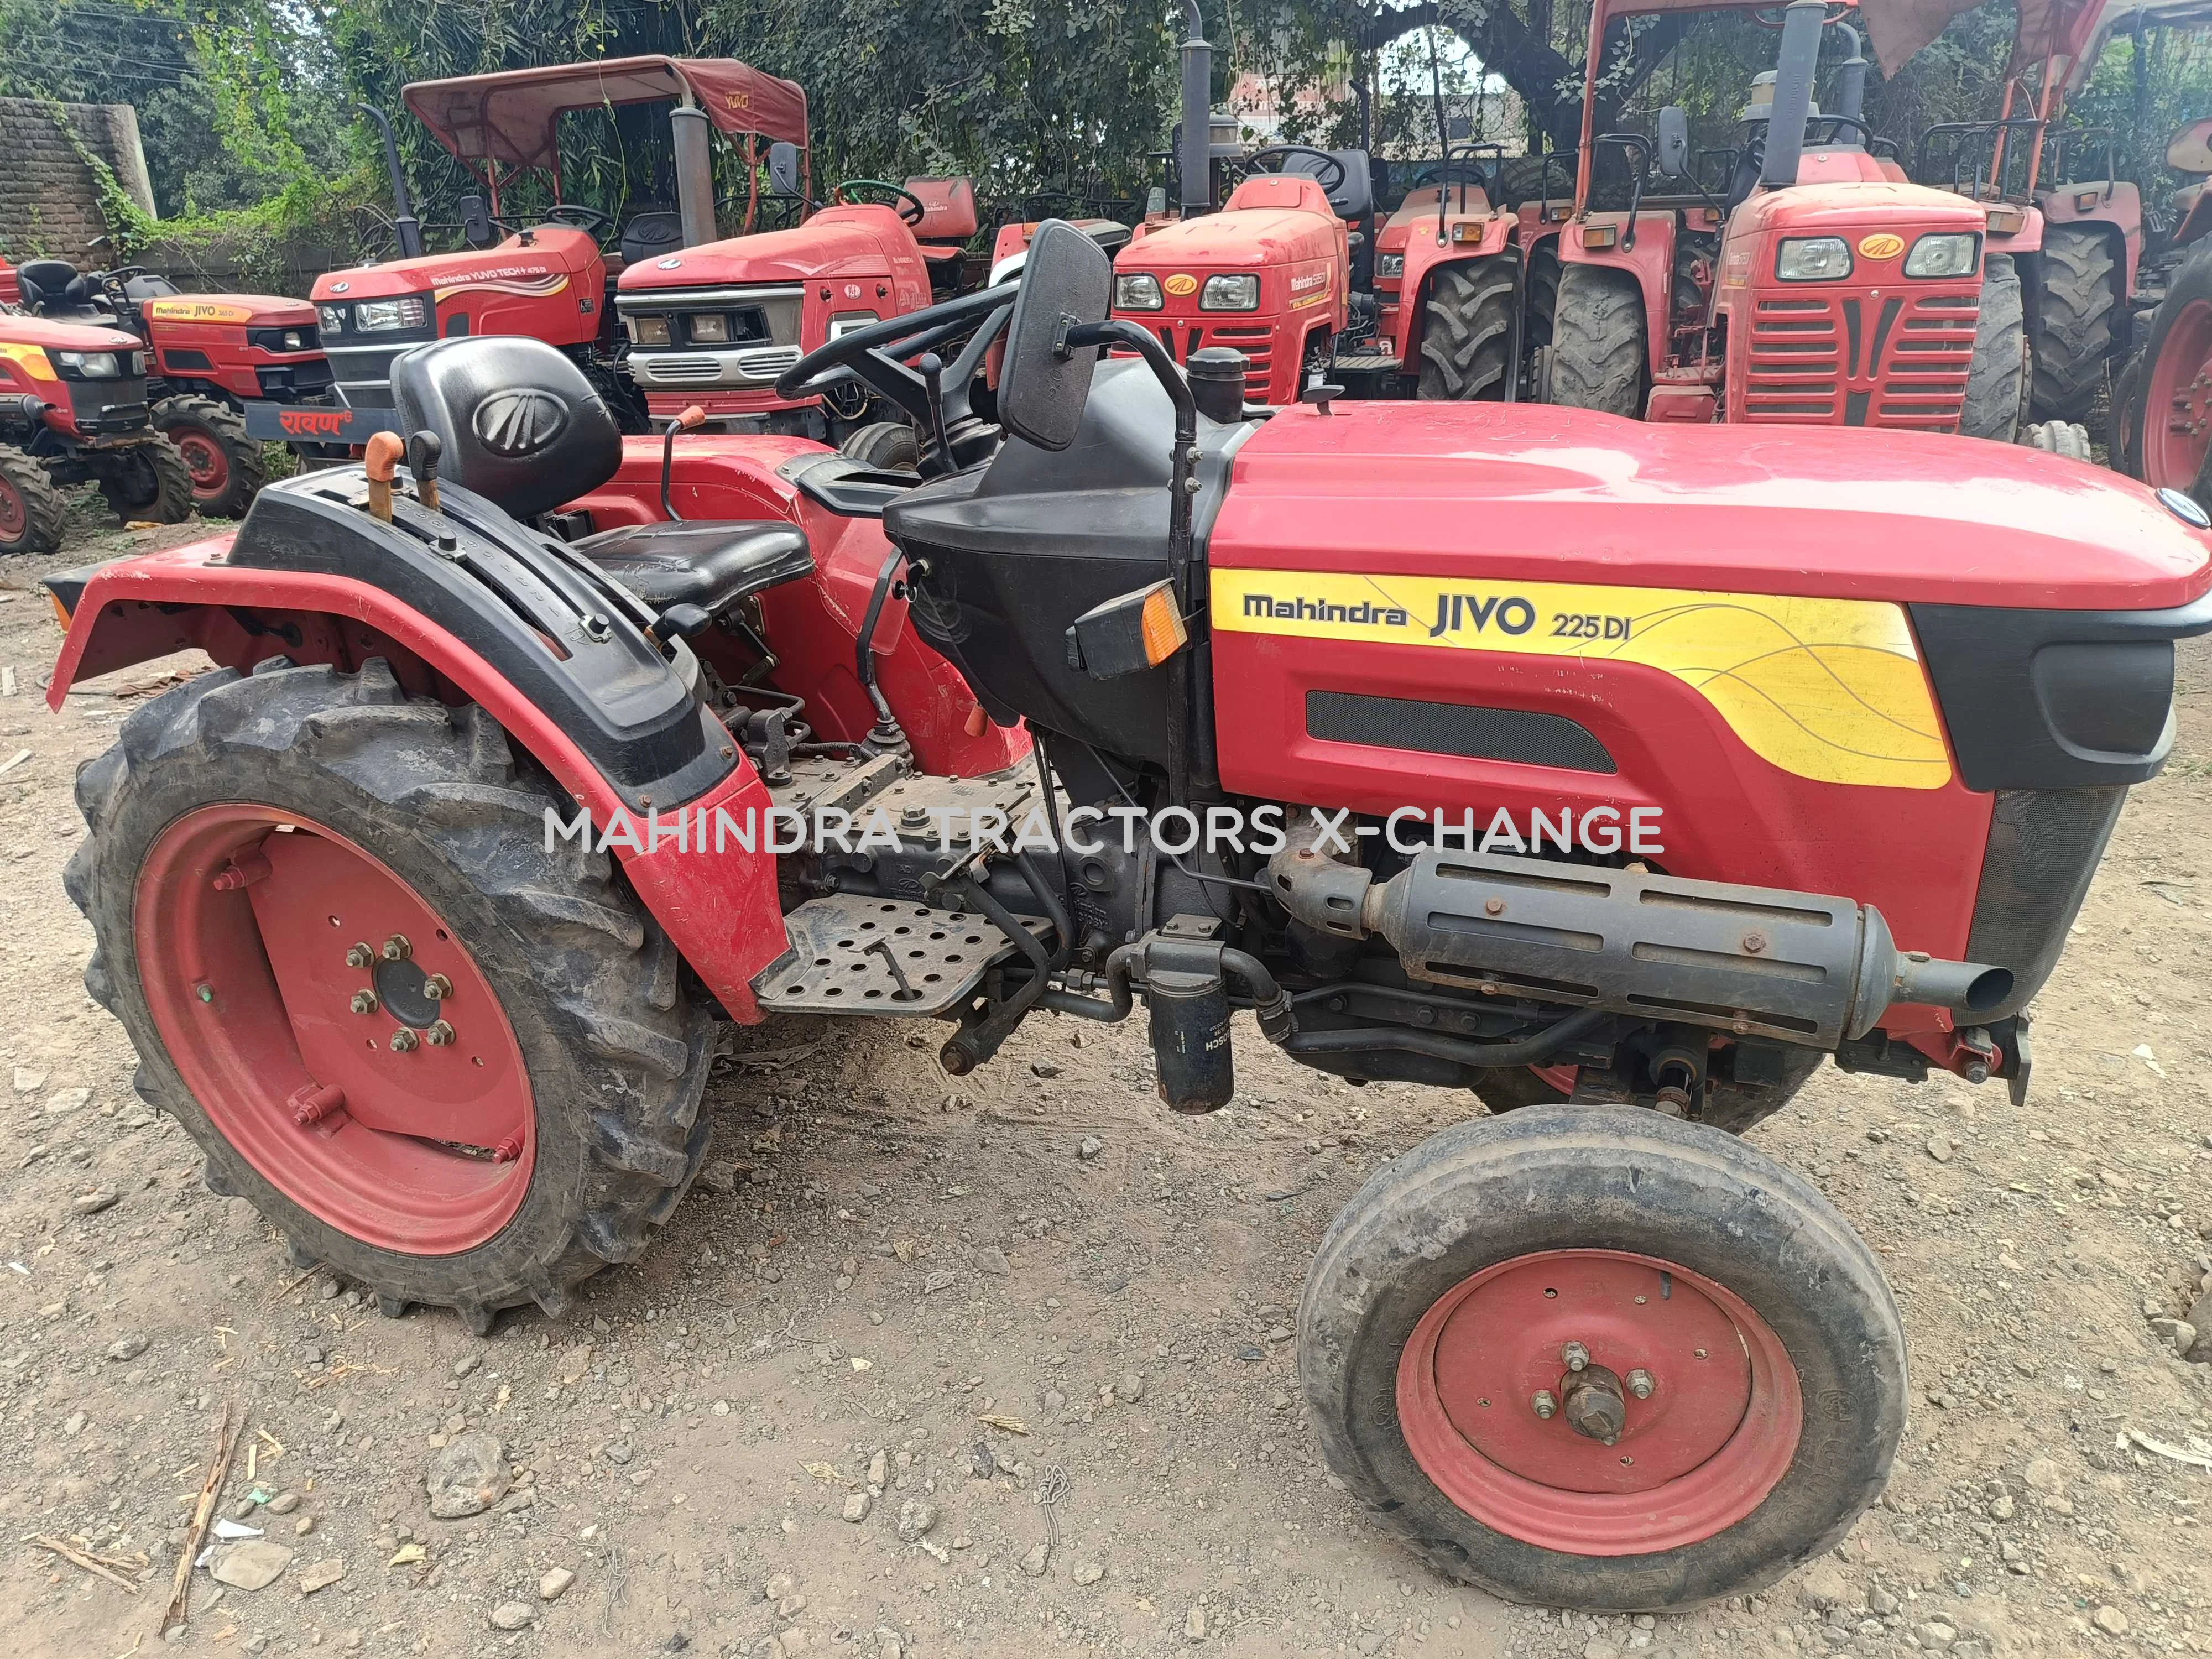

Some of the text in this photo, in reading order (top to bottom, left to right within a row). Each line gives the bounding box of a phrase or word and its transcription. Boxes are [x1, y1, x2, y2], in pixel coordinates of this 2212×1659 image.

[725, 95, 748, 109] YUVO
[430, 274, 472, 286] Mahindra
[469, 269, 497, 280] YUVO
[1291, 275, 1313, 291] Mahindra
[194, 305, 216, 317] JIVO
[279, 410, 341, 436] रावण
[1243, 593, 1631, 641] Mahindra JIVO 225 DI
